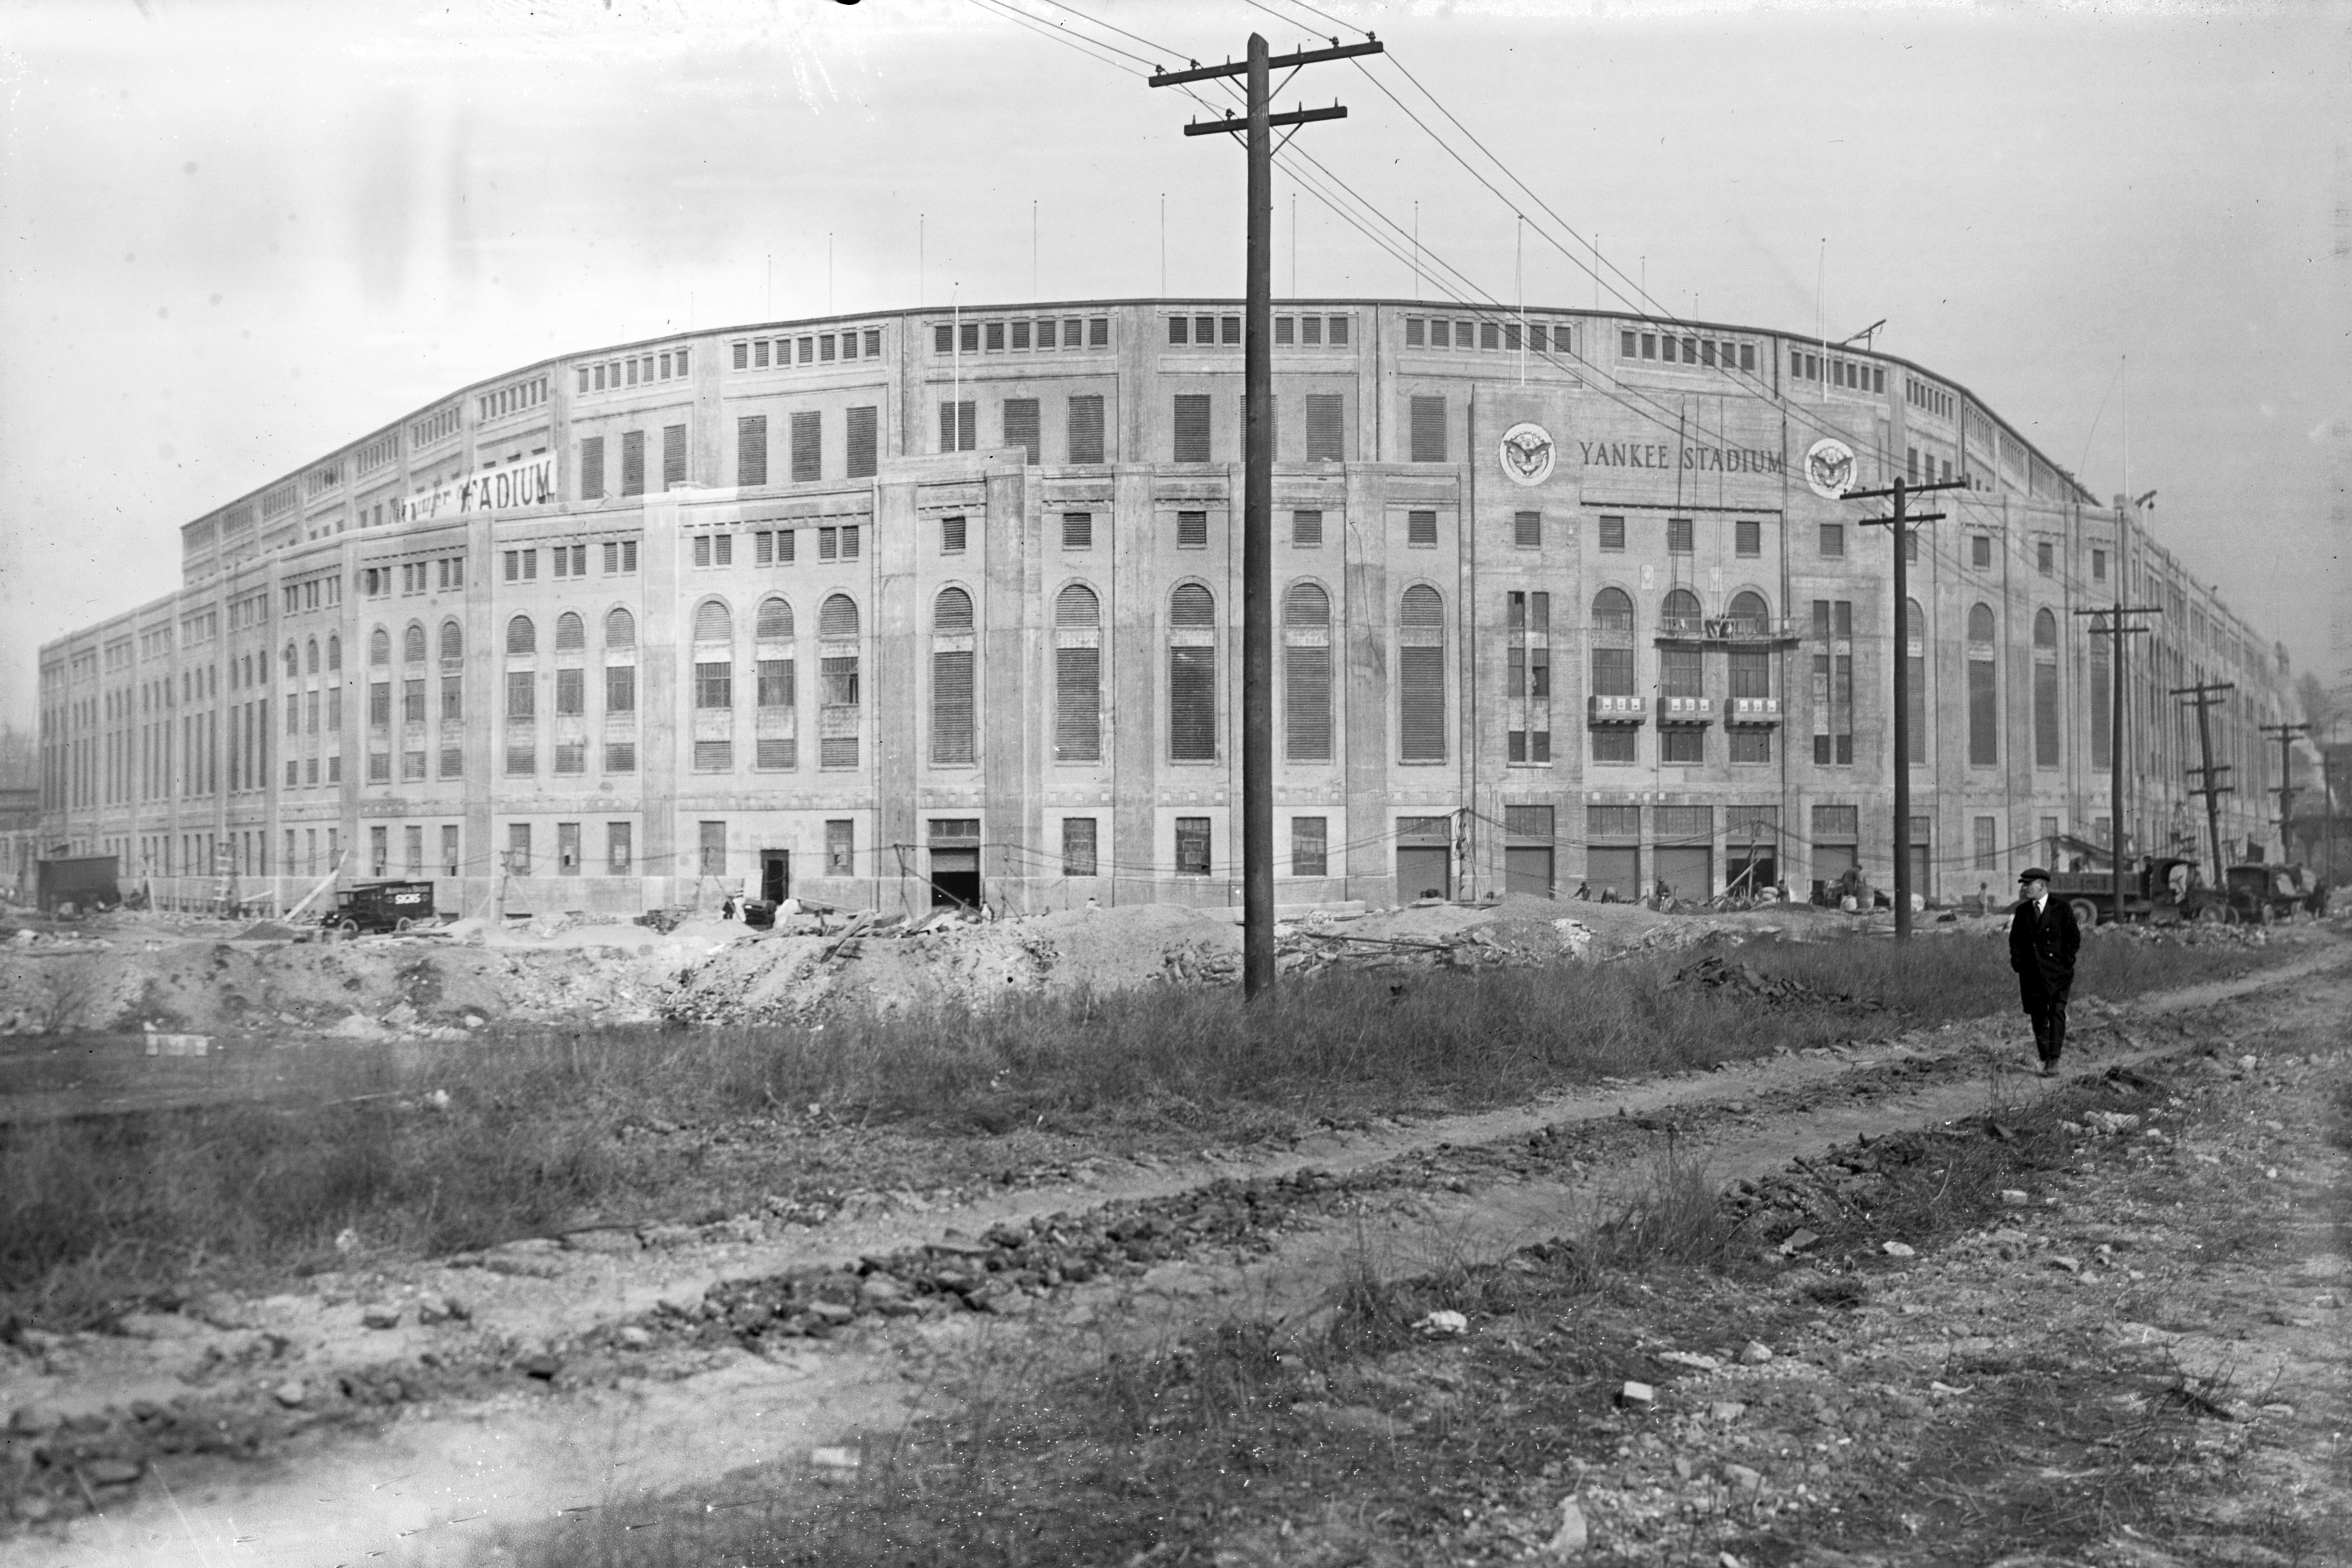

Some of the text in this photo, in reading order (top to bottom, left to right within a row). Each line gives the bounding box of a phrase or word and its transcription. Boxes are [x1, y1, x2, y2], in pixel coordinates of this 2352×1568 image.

[1579, 441, 1783, 474] YANKEE STADIUM
[458, 460, 551, 511] ADIUM
